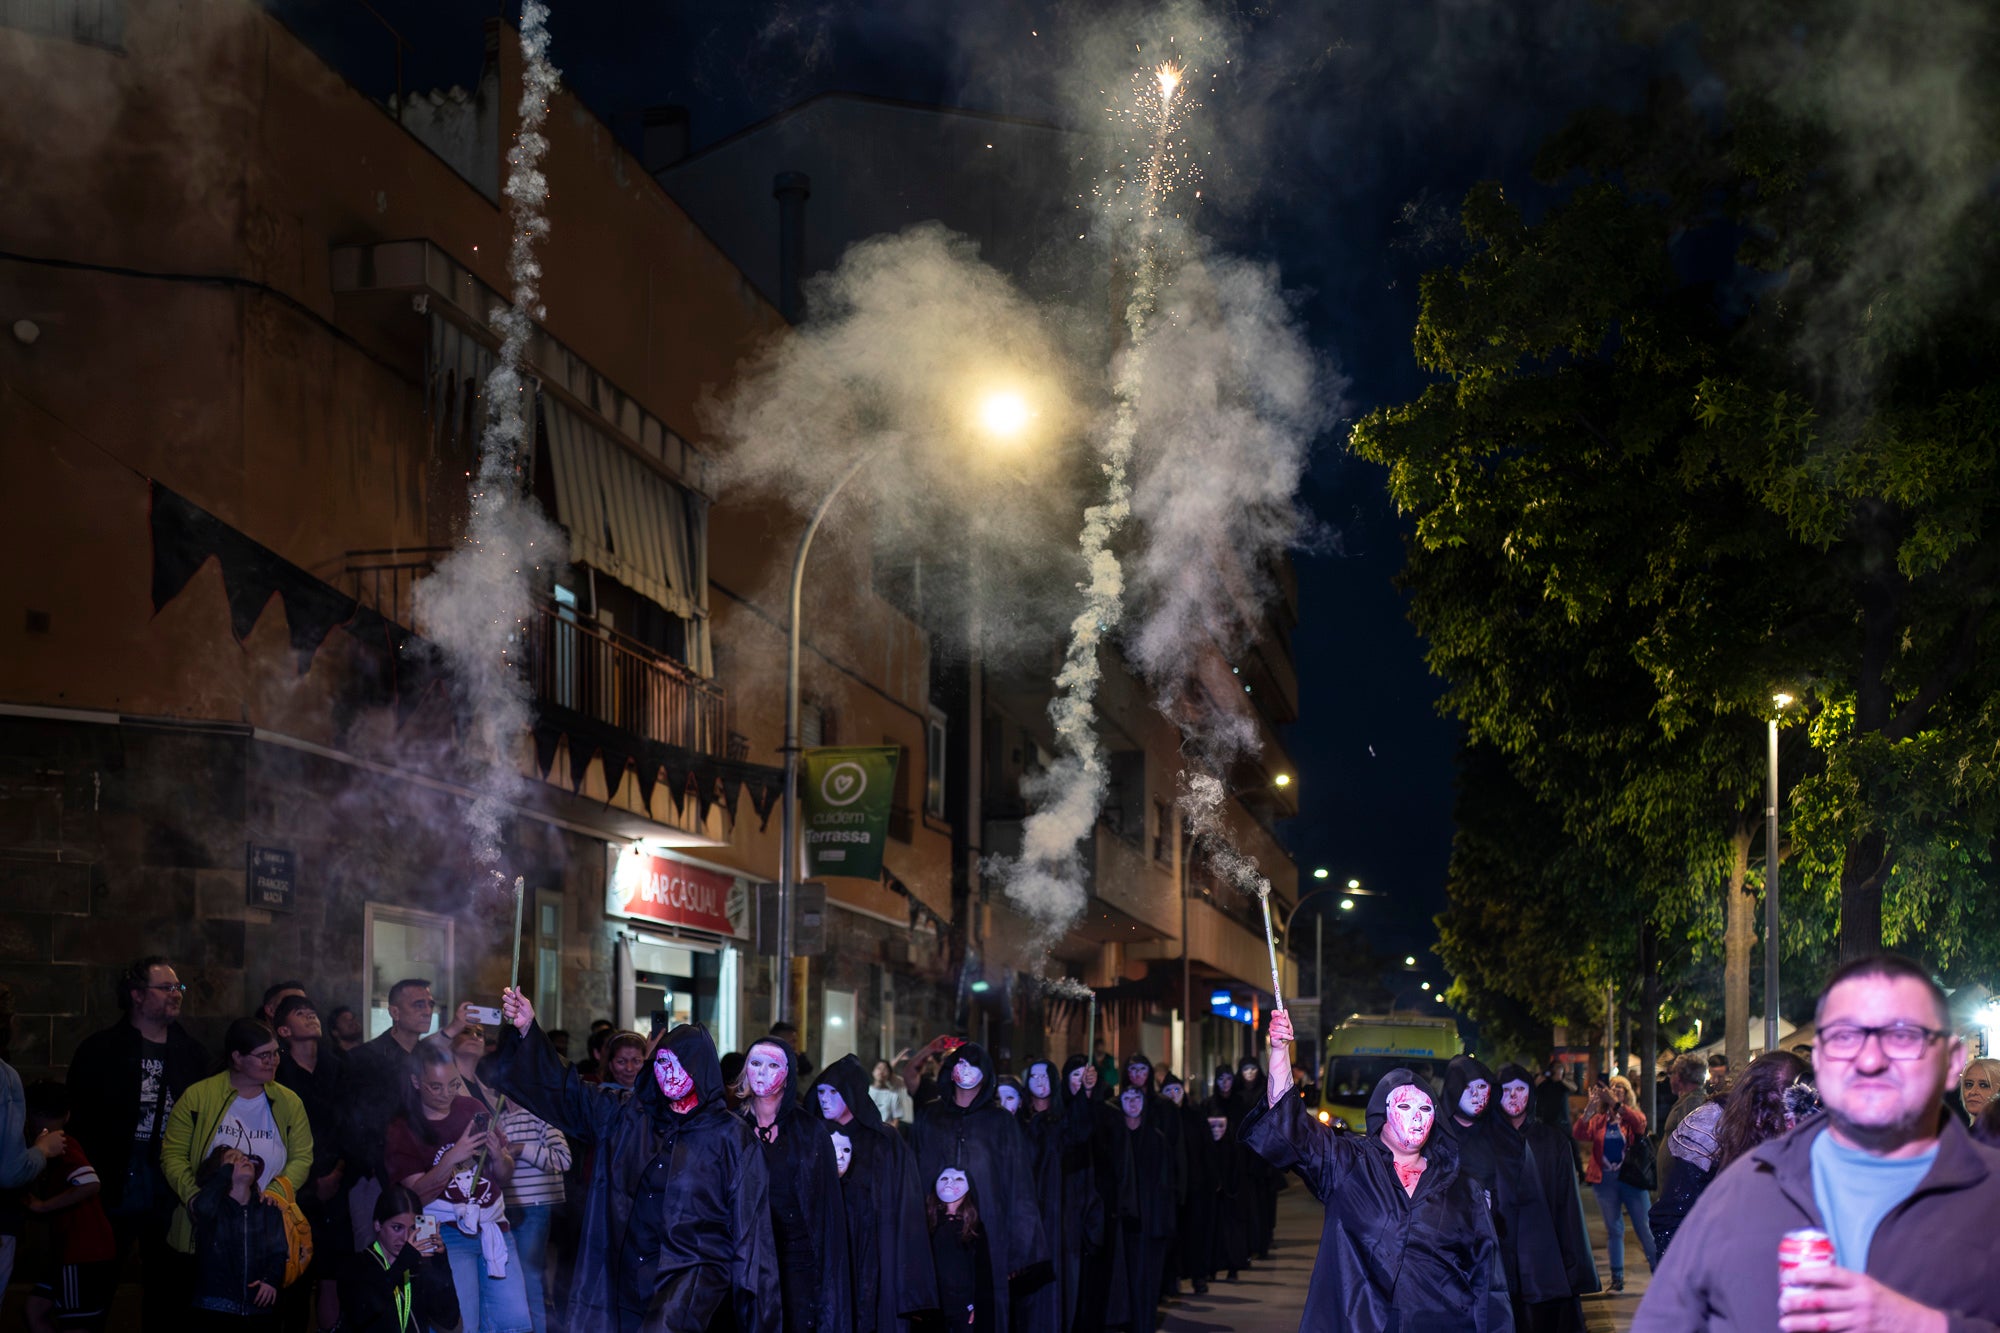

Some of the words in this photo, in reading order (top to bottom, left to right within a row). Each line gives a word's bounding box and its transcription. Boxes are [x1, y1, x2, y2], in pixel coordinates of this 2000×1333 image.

[812, 810, 865, 825] cuidem
[806, 829, 871, 844] Terrassa
[641, 871, 669, 905] BAR
[669, 876, 720, 917] CASUAL
[217, 1124, 243, 1138] WEET
[249, 1129, 273, 1139] LIFE
